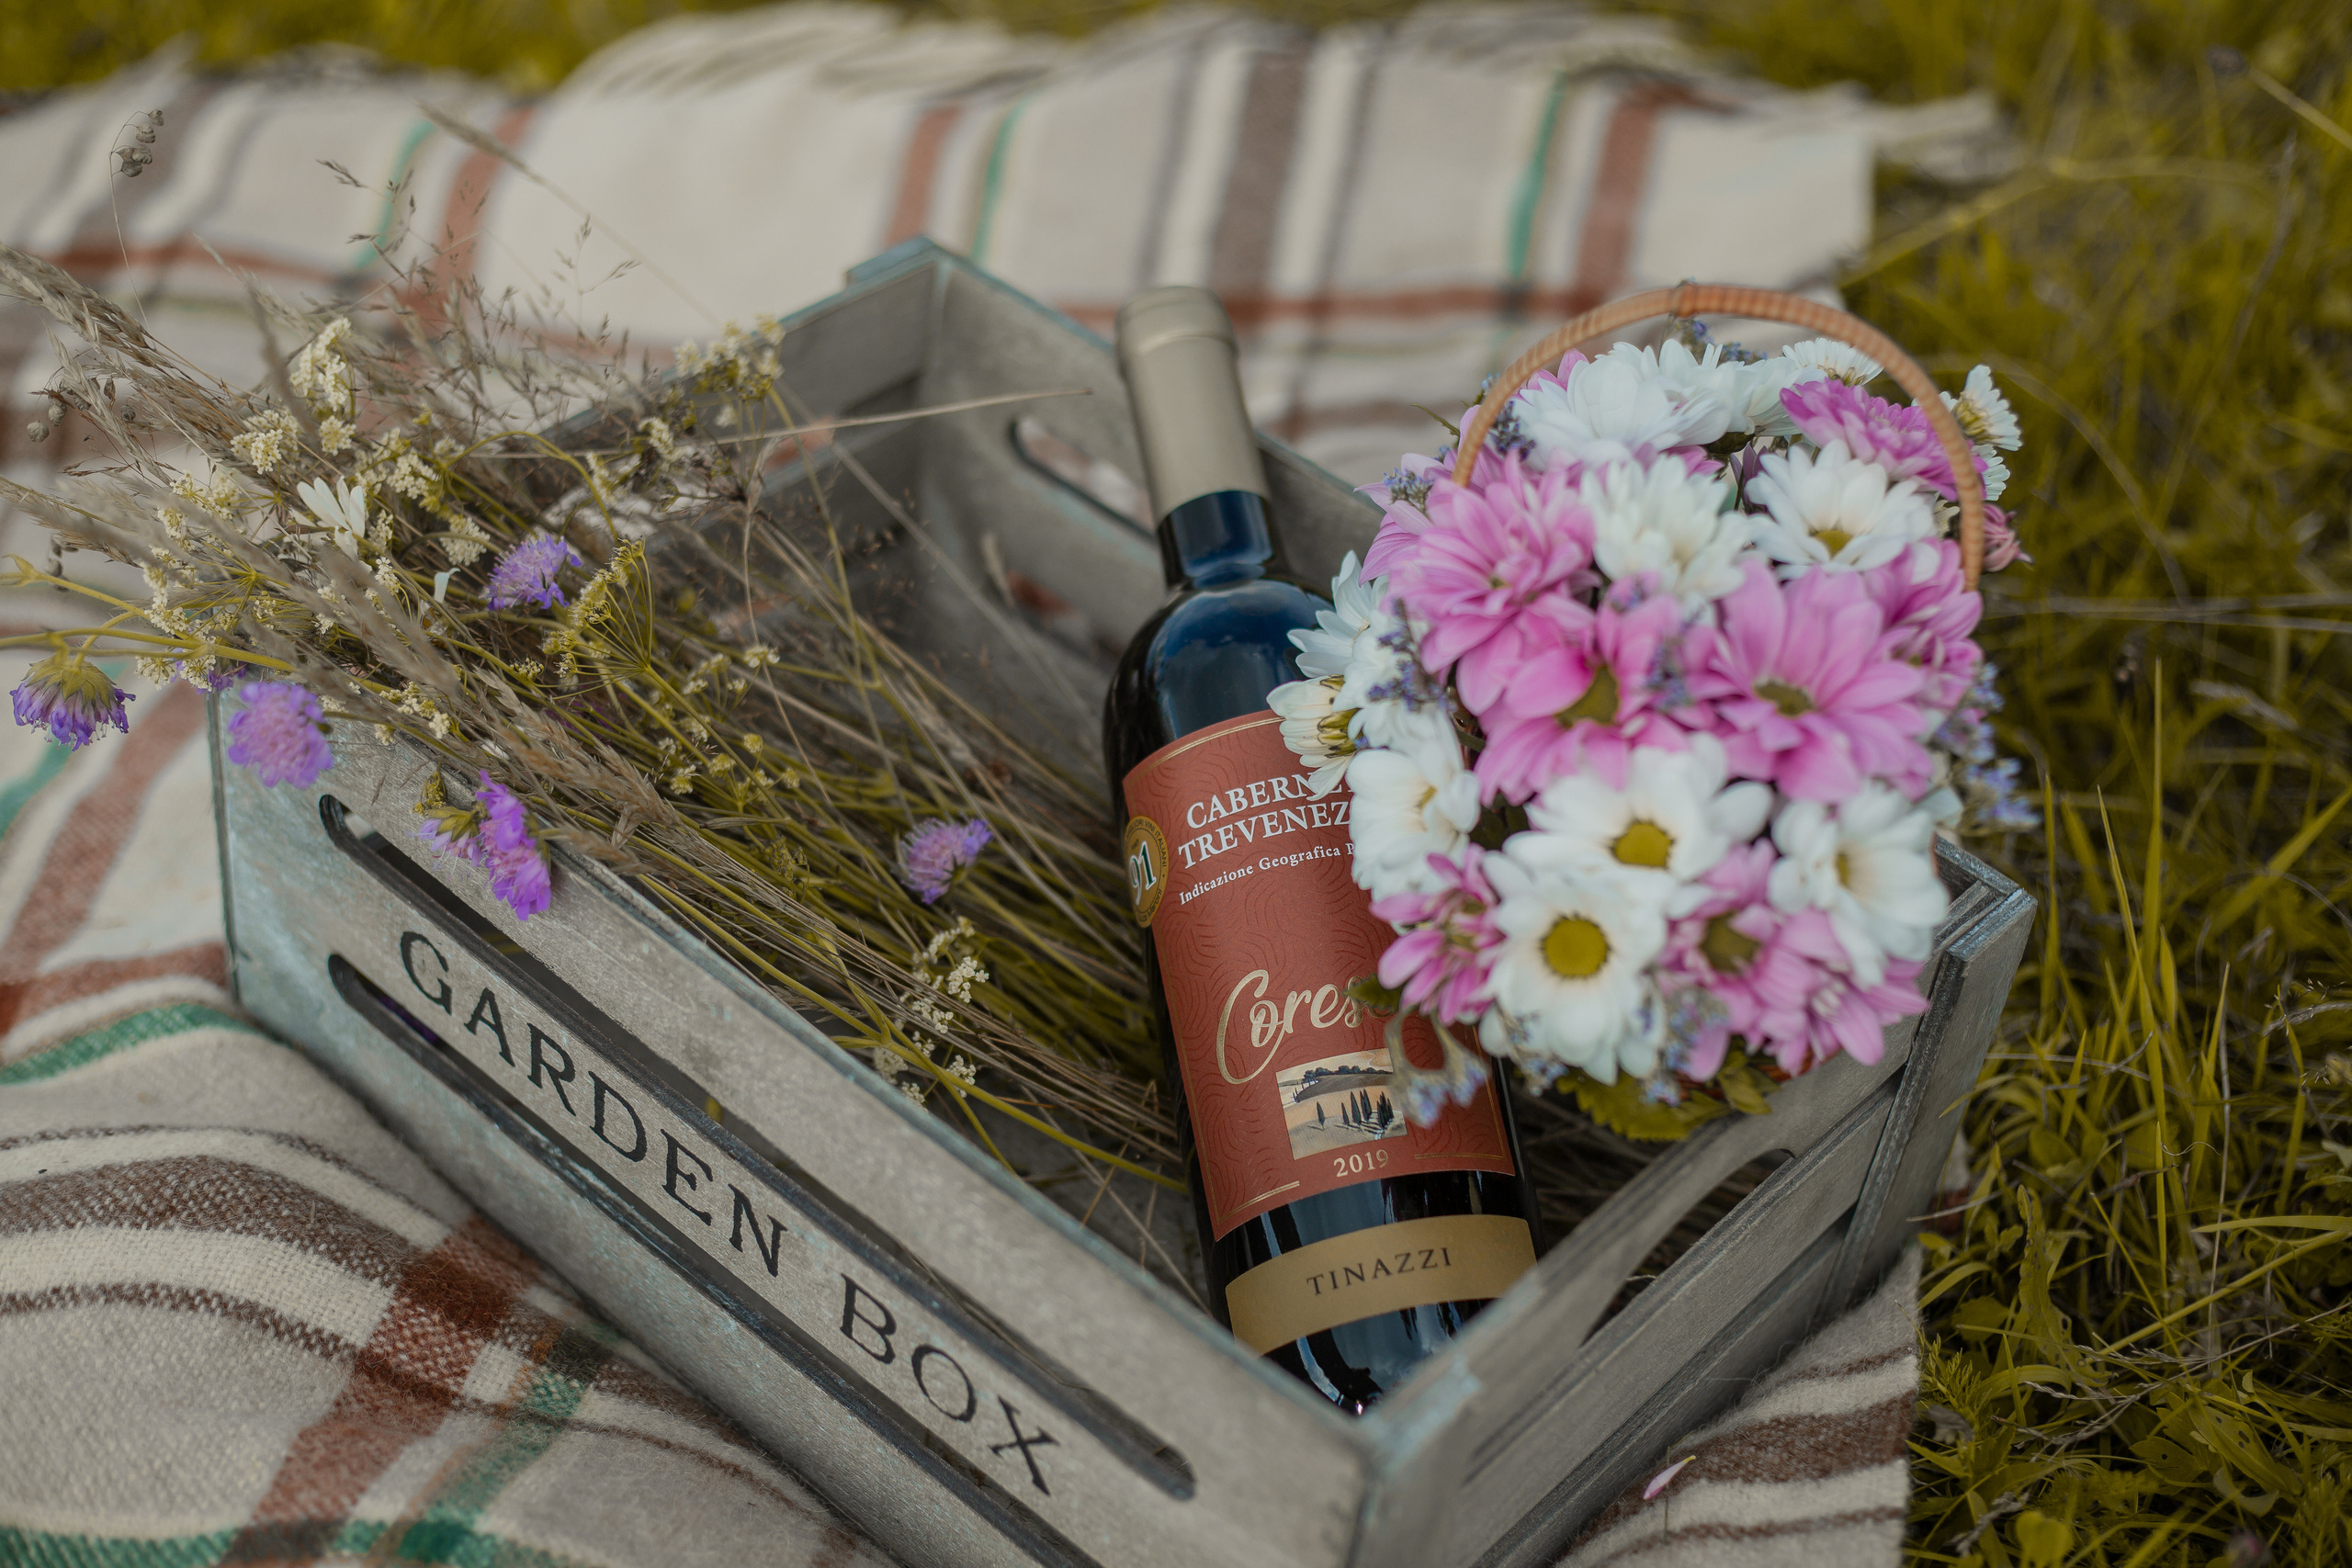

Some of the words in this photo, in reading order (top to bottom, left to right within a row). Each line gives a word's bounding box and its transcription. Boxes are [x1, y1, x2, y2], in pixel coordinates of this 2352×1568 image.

[1186, 773, 1355, 829] CABERN
[1129, 840, 1158, 906] 91
[1179, 864, 1255, 906] Indicazione
[1258, 845, 1341, 871] Geografica
[1216, 969, 1391, 1085] Cores
[1333, 1149, 1389, 1178] 2019
[400, 931, 788, 1278] GARDEN
[839, 1271, 1060, 1497] BOX
[1306, 1247, 1453, 1296] TINAZZI
